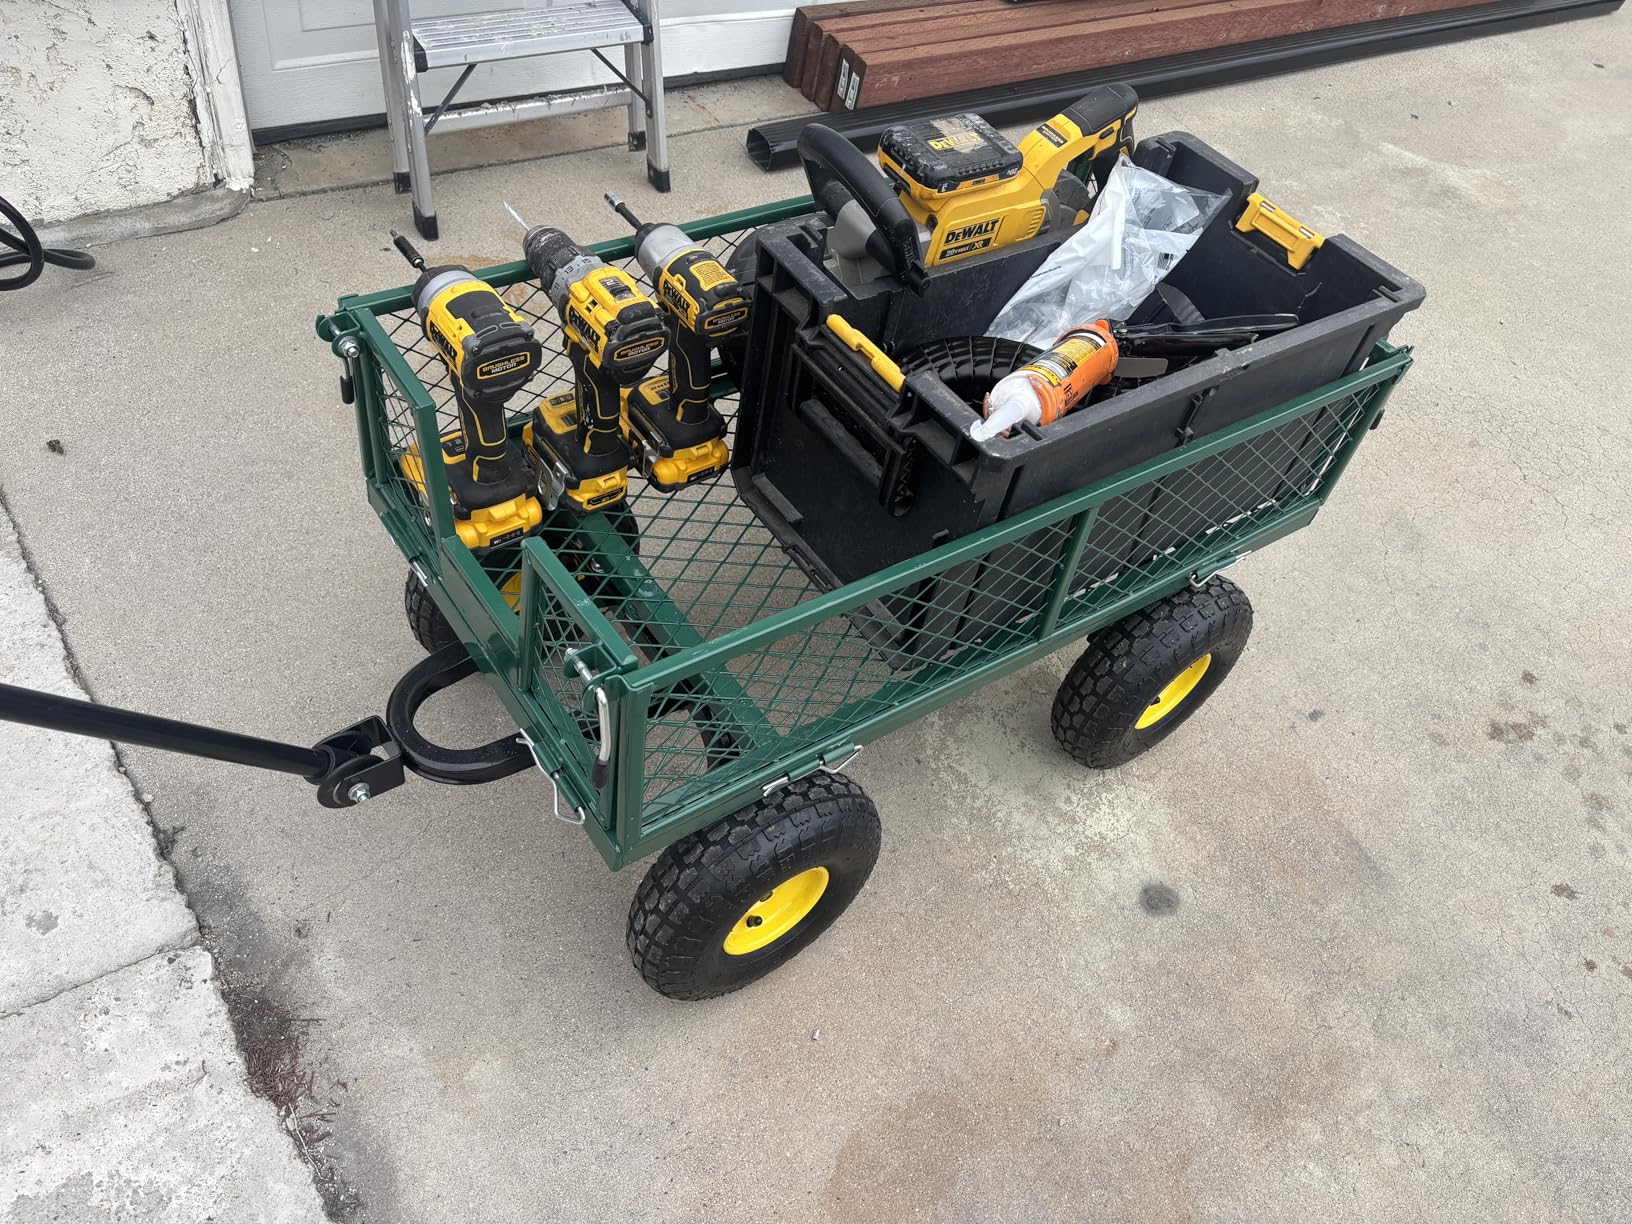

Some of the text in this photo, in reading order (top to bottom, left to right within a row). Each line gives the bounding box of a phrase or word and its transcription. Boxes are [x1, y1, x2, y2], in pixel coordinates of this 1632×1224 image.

[944, 218, 1000, 245] DEWALT
[564, 265, 574, 275] 13
[482, 355, 526, 372] BRUSHLESS
[491, 362, 517, 374] MOTOR
